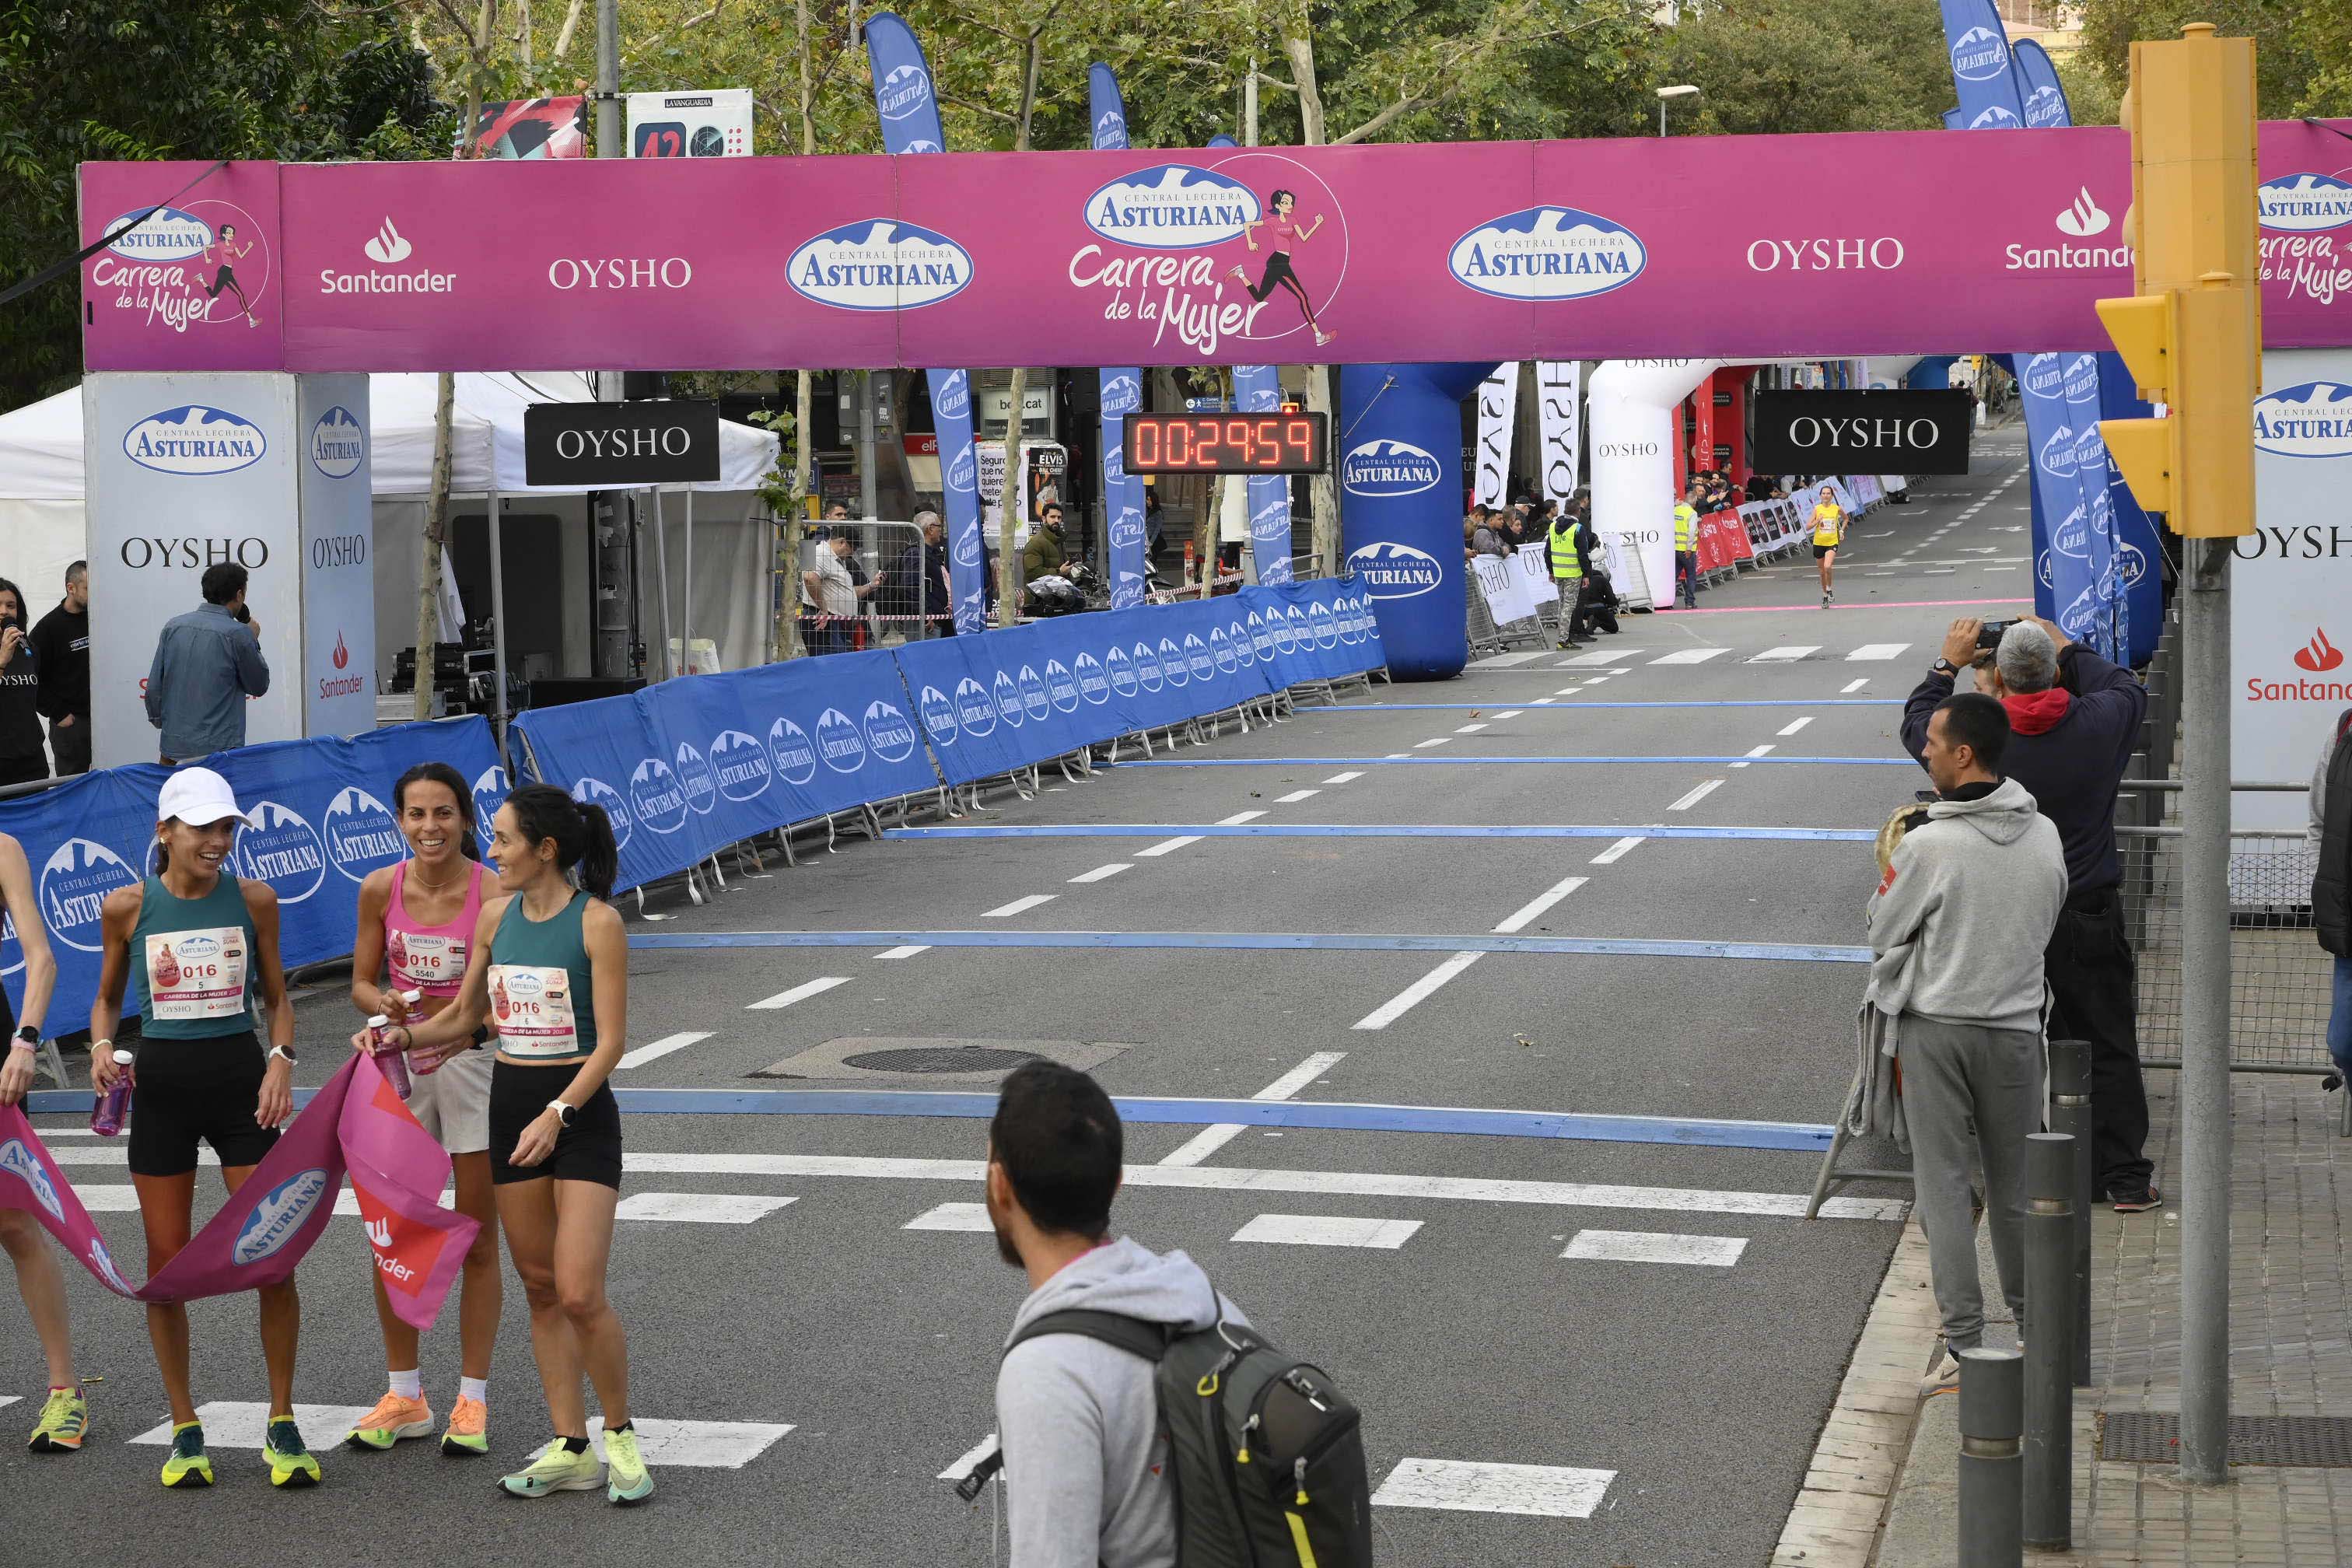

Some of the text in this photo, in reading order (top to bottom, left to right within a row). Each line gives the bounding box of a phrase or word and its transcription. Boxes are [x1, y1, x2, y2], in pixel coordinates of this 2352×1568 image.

[641, 131, 681, 157] 42
[1125, 192, 1242, 203] CENTRAL LECHERA
[1099, 197, 1246, 228] ASTURIANA
[111, 225, 205, 248] ASTURIANA
[1494, 237, 1625, 248] CENTRAL LECHERA
[2258, 236, 2334, 259] arrera
[829, 250, 953, 260] CENTRAL LECHERA
[1069, 244, 1215, 288] Carrera
[1464, 243, 1630, 277] ASTURIANA
[1747, 237, 1904, 271] OYSHO
[93, 259, 184, 287] Carrera
[320, 268, 457, 293] Santander
[548, 257, 691, 289] OYSHO
[800, 253, 959, 287] ASTURIANA
[2277, 259, 2291, 281] la
[116, 283, 221, 332] de la Mujer
[1104, 280, 1269, 355] de la Mujer
[135, 432, 255, 457] ASTURIANA
[556, 427, 691, 457] OYSHO
[1137, 422, 1310, 464] 00:29:59
[1789, 417, 1939, 448] OYSHO
[316, 435, 360, 460] ASTURIANA
[1039, 455, 1063, 464] ELVIS
[1599, 443, 1657, 457] OYSHO
[1346, 463, 1433, 484] ASTURIANA
[121, 537, 268, 568] OYSHO
[313, 534, 365, 569] OYSHO
[320, 676, 363, 699] Santander
[340, 817, 390, 832] CENTRAL LECHERA
[252, 831, 310, 850] CENTRAL LECHERA
[332, 827, 402, 863] ASTURIANA
[244, 844, 321, 880] ASTURIANA
[58, 869, 125, 892] CENTRAL LECHERA
[179, 946, 216, 954] ASTURIANA
[408, 936, 443, 946] ASTURIANA
[183, 964, 217, 978] 016
[410, 954, 441, 968] 016
[415, 970, 435, 978] 5540
[512, 1001, 540, 1013] 016
[241, 1178, 324, 1259] ASTURIANA
